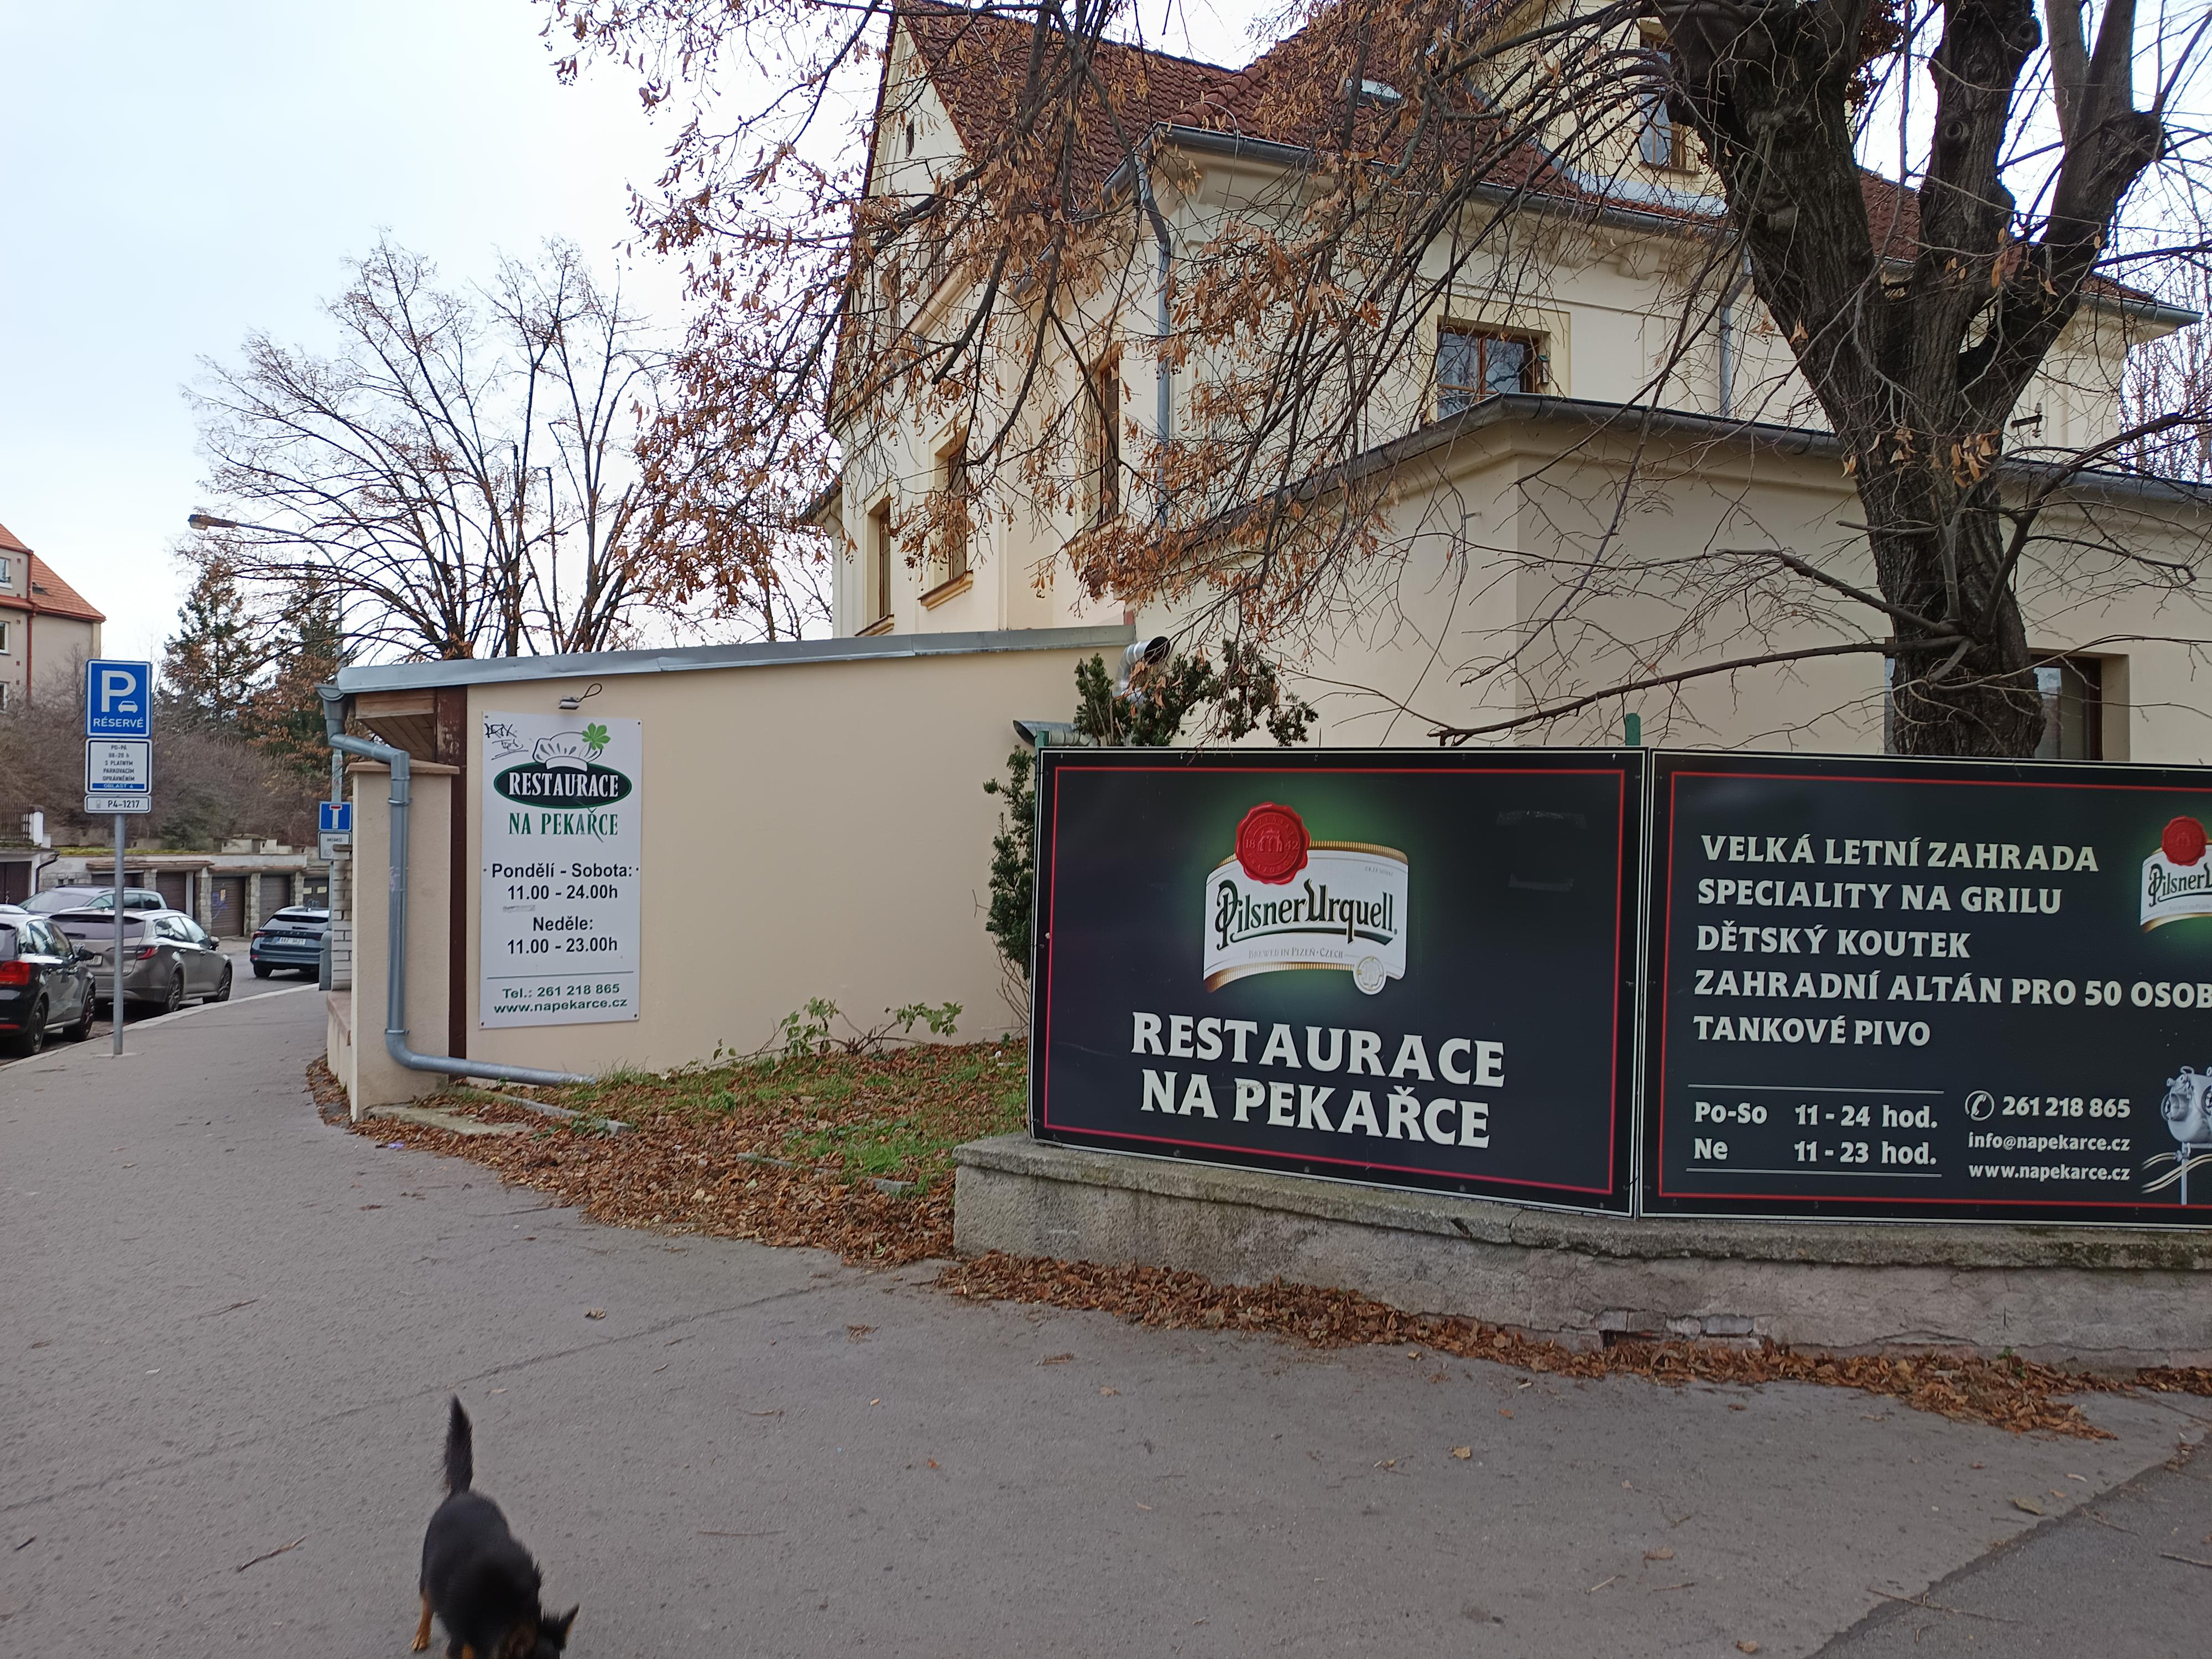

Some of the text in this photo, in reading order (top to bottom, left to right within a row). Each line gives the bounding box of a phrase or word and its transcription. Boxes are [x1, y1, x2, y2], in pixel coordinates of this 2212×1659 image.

[101, 670, 136, 712] P
[93, 716, 144, 728] RÉSERVÉ
[509, 773, 618, 797] RESTAURACE
[108, 800, 140, 808] P4-1217
[509, 807, 618, 843] NA PEKAŘCE
[1245, 839, 1300, 851] 18 42
[1701, 834, 2099, 872] VELKÁ LETNÍ ZAHRADA
[493, 863, 554, 878] Pondělí
[572, 863, 632, 877] Sobota:
[508, 885, 549, 899] 11.00
[567, 885, 617, 899] 24.00h
[1698, 879, 2062, 914] SPECIALITY NA GRILU
[534, 916, 592, 931] Neděle:
[508, 939, 548, 954] 11.00
[566, 937, 617, 952] 23.00h
[1697, 920, 1970, 958] DĚTSKÝ KOUTEK
[503, 984, 619, 998] Tel.: 261 218 865
[1695, 970, 2212, 1008] ZAHRADNÍ ALTÁN PRO 50 OSOB
[494, 997, 627, 1013] www.napekarce.cz
[1693, 1015, 1929, 1046] TANKOVÉ PIVO
[1131, 1012, 1504, 1087] RESTAURACE
[1141, 1069, 1490, 1148] NA PEKAŘCE
[1695, 1102, 1767, 1124] Po-So
[1795, 1105, 1818, 1125] 11
[1841, 1105, 1870, 1126] 24
[1882, 1105, 1937, 1128] hod.
[2002, 1096, 2130, 1118] 261 218 865
[1694, 1138, 1728, 1160] Ne
[1794, 1141, 1817, 1161] 11
[1840, 1142, 1868, 1163] 23
[1882, 1141, 1936, 1164] hod.
[1969, 1132, 2130, 1152] info@napekarce.cz
[1969, 1164, 2130, 1181] www.napekarce.cz
